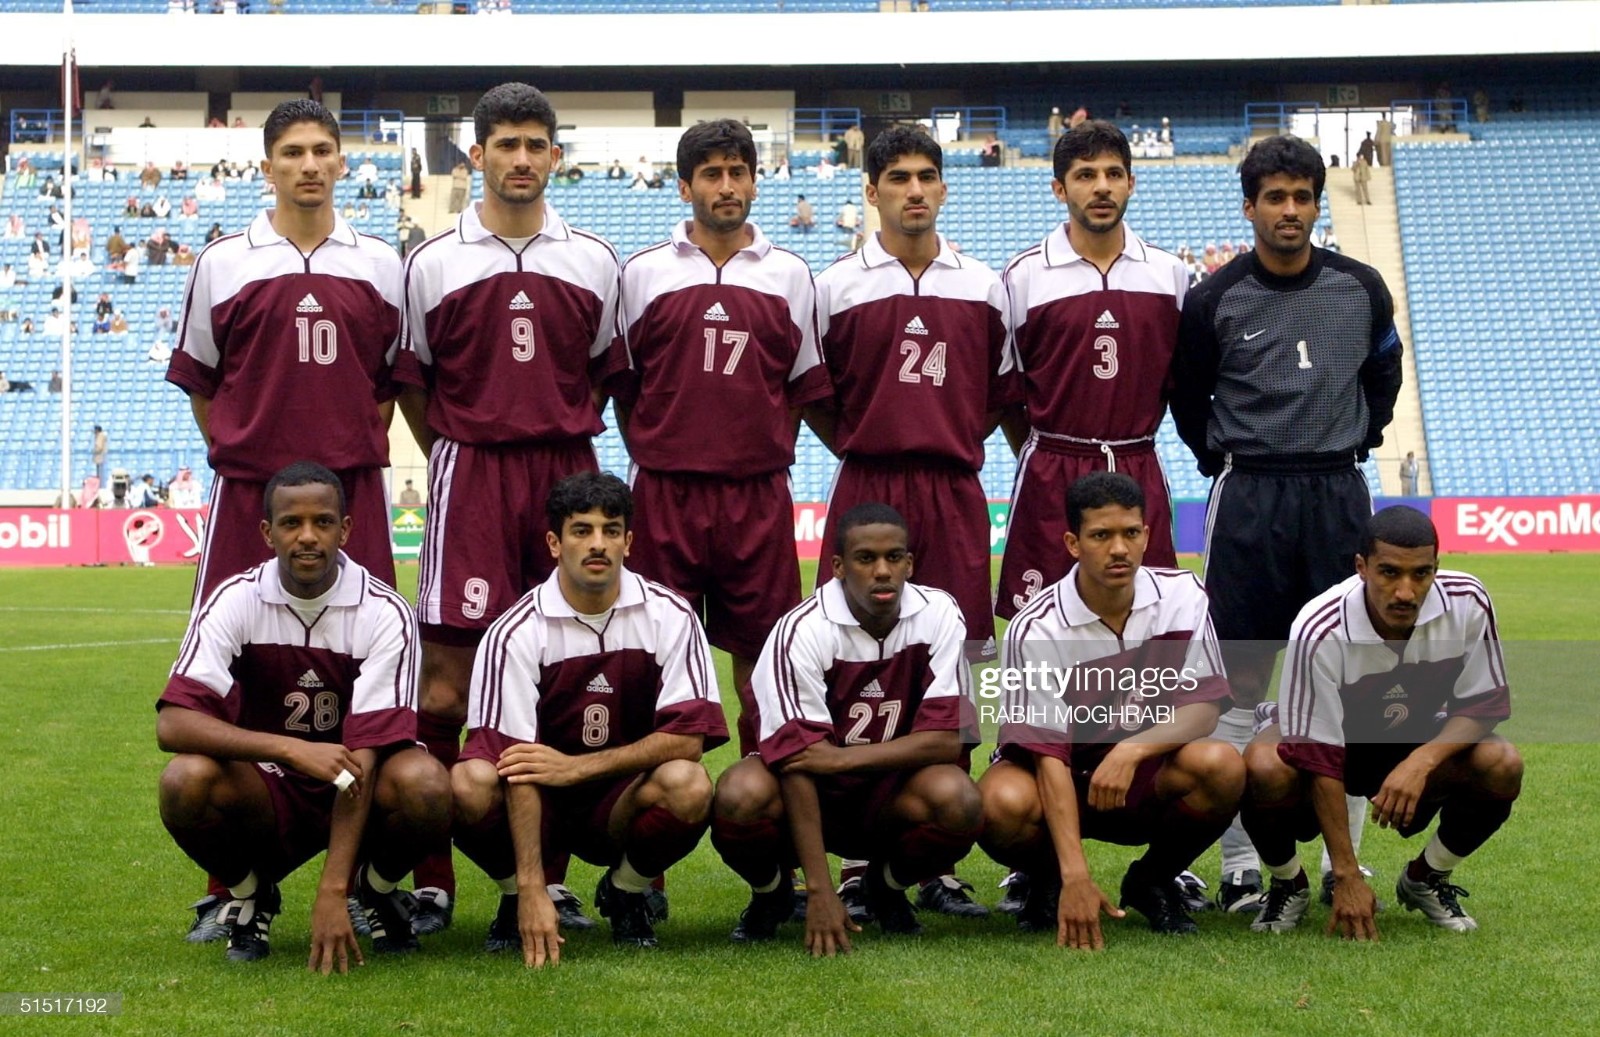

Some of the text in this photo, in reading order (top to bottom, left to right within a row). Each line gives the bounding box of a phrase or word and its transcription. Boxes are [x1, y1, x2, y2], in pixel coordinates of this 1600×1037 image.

[296, 317, 337, 365] 10
[511, 317, 535, 362] 9
[704, 328, 750, 375] 17
[1093, 335, 1118, 379] 3
[1296, 340, 1313, 369] 1
[899, 340, 947, 386] 24
[461, 577, 489, 619] 9
[1013, 569, 1043, 610] 3
[297, 680, 325, 688] adidas
[586, 685, 614, 694] adidas
[284, 691, 339, 732] 28
[582, 703, 610, 747] 8
[845, 700, 902, 745] 27
